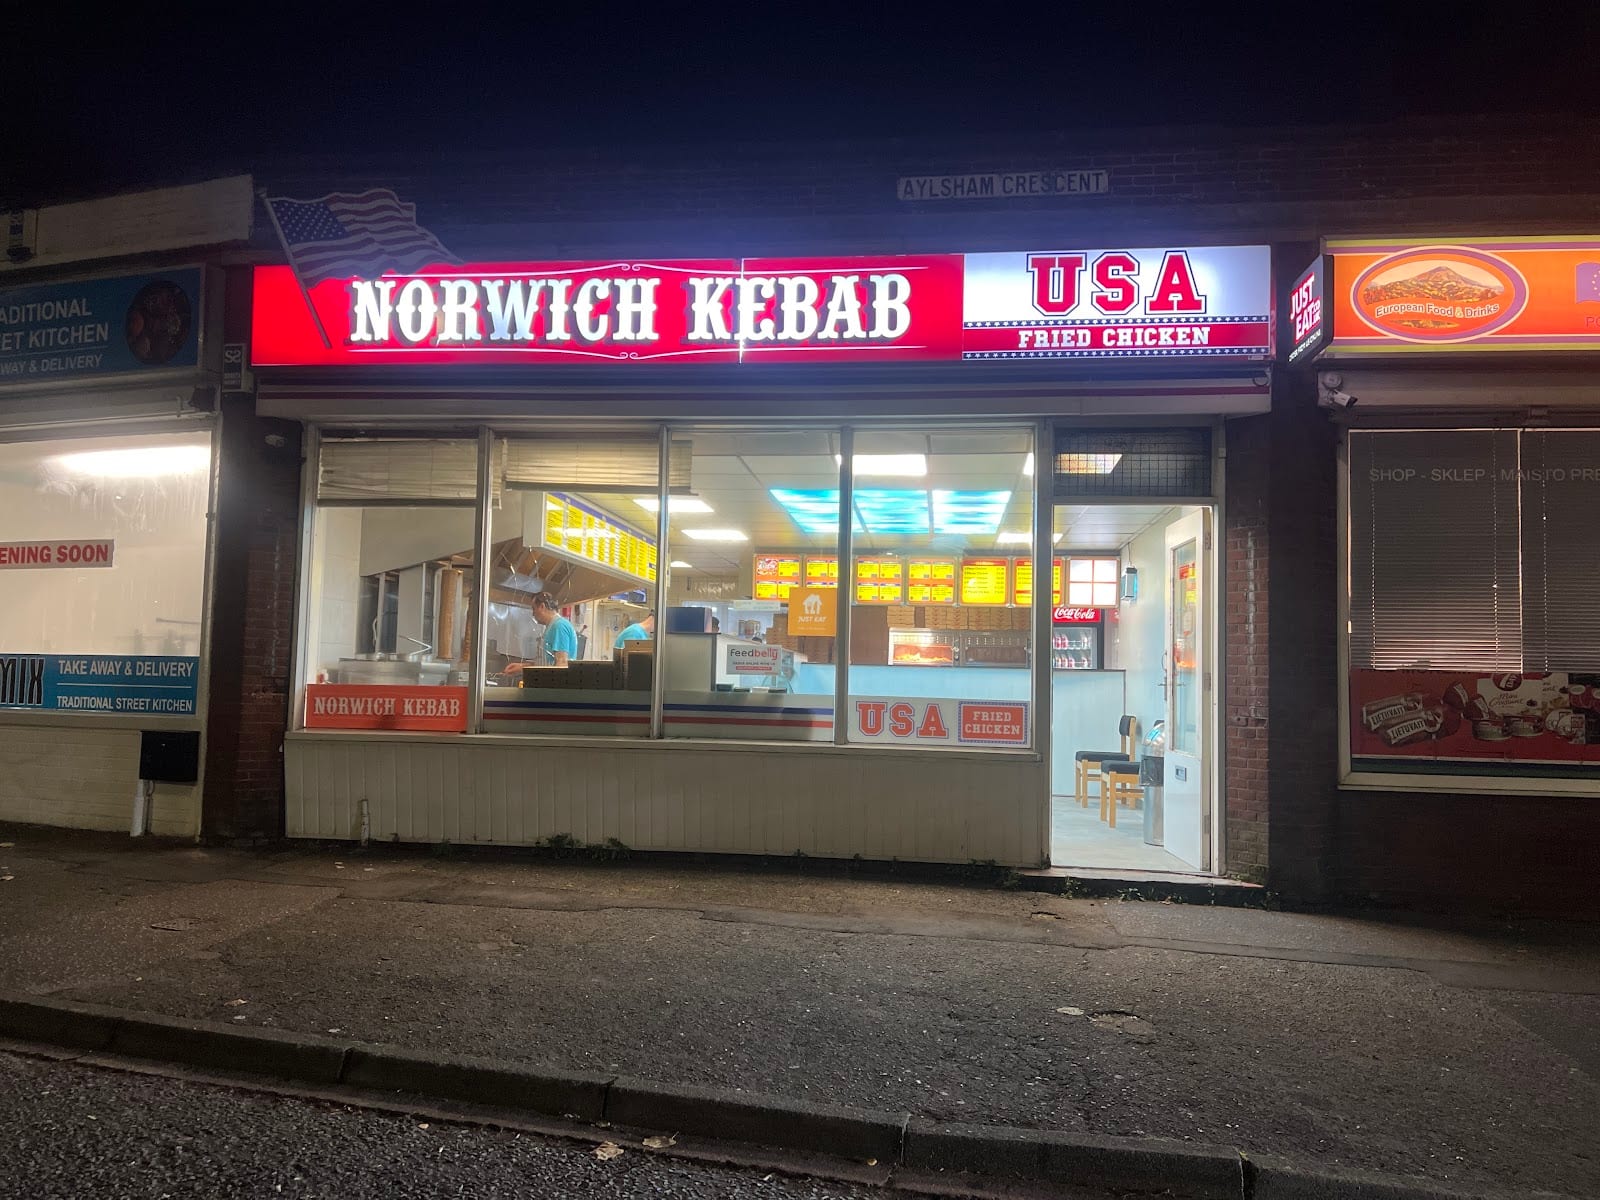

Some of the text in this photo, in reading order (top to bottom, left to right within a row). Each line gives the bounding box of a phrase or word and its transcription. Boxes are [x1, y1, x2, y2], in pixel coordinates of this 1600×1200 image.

[903, 172, 1103, 197] AYLSHAM CRESCENT
[1026, 250, 1206, 316] USA
[1290, 274, 1315, 320] JUST
[350, 273, 912, 343] NORWICH KEBAB
[1375, 302, 1499, 318] European Food & Drinks
[29, 322, 109, 348] KITCHEN
[1018, 326, 1211, 348] FRIED CHICKEN
[29, 359, 39, 373] &
[41, 353, 103, 372] DELIVERY
[1369, 468, 1416, 481] SHOP
[1431, 468, 1486, 481] SKLEP
[1501, 468, 1565, 481] MAISTO
[56, 544, 108, 563] SOON
[798, 615, 827, 624] JUST EAT
[58, 659, 194, 678] TAKE AWAY & DELIVERY
[57, 695, 192, 712] TRADITIONAL STREET KITCHEN
[313, 697, 460, 717] NORWICH KEBAB
[856, 701, 949, 739] USA
[973, 711, 1012, 722] FRIED
[965, 723, 1020, 735] CHICKEN
[1391, 719, 1427, 739] LIETUVAIT
